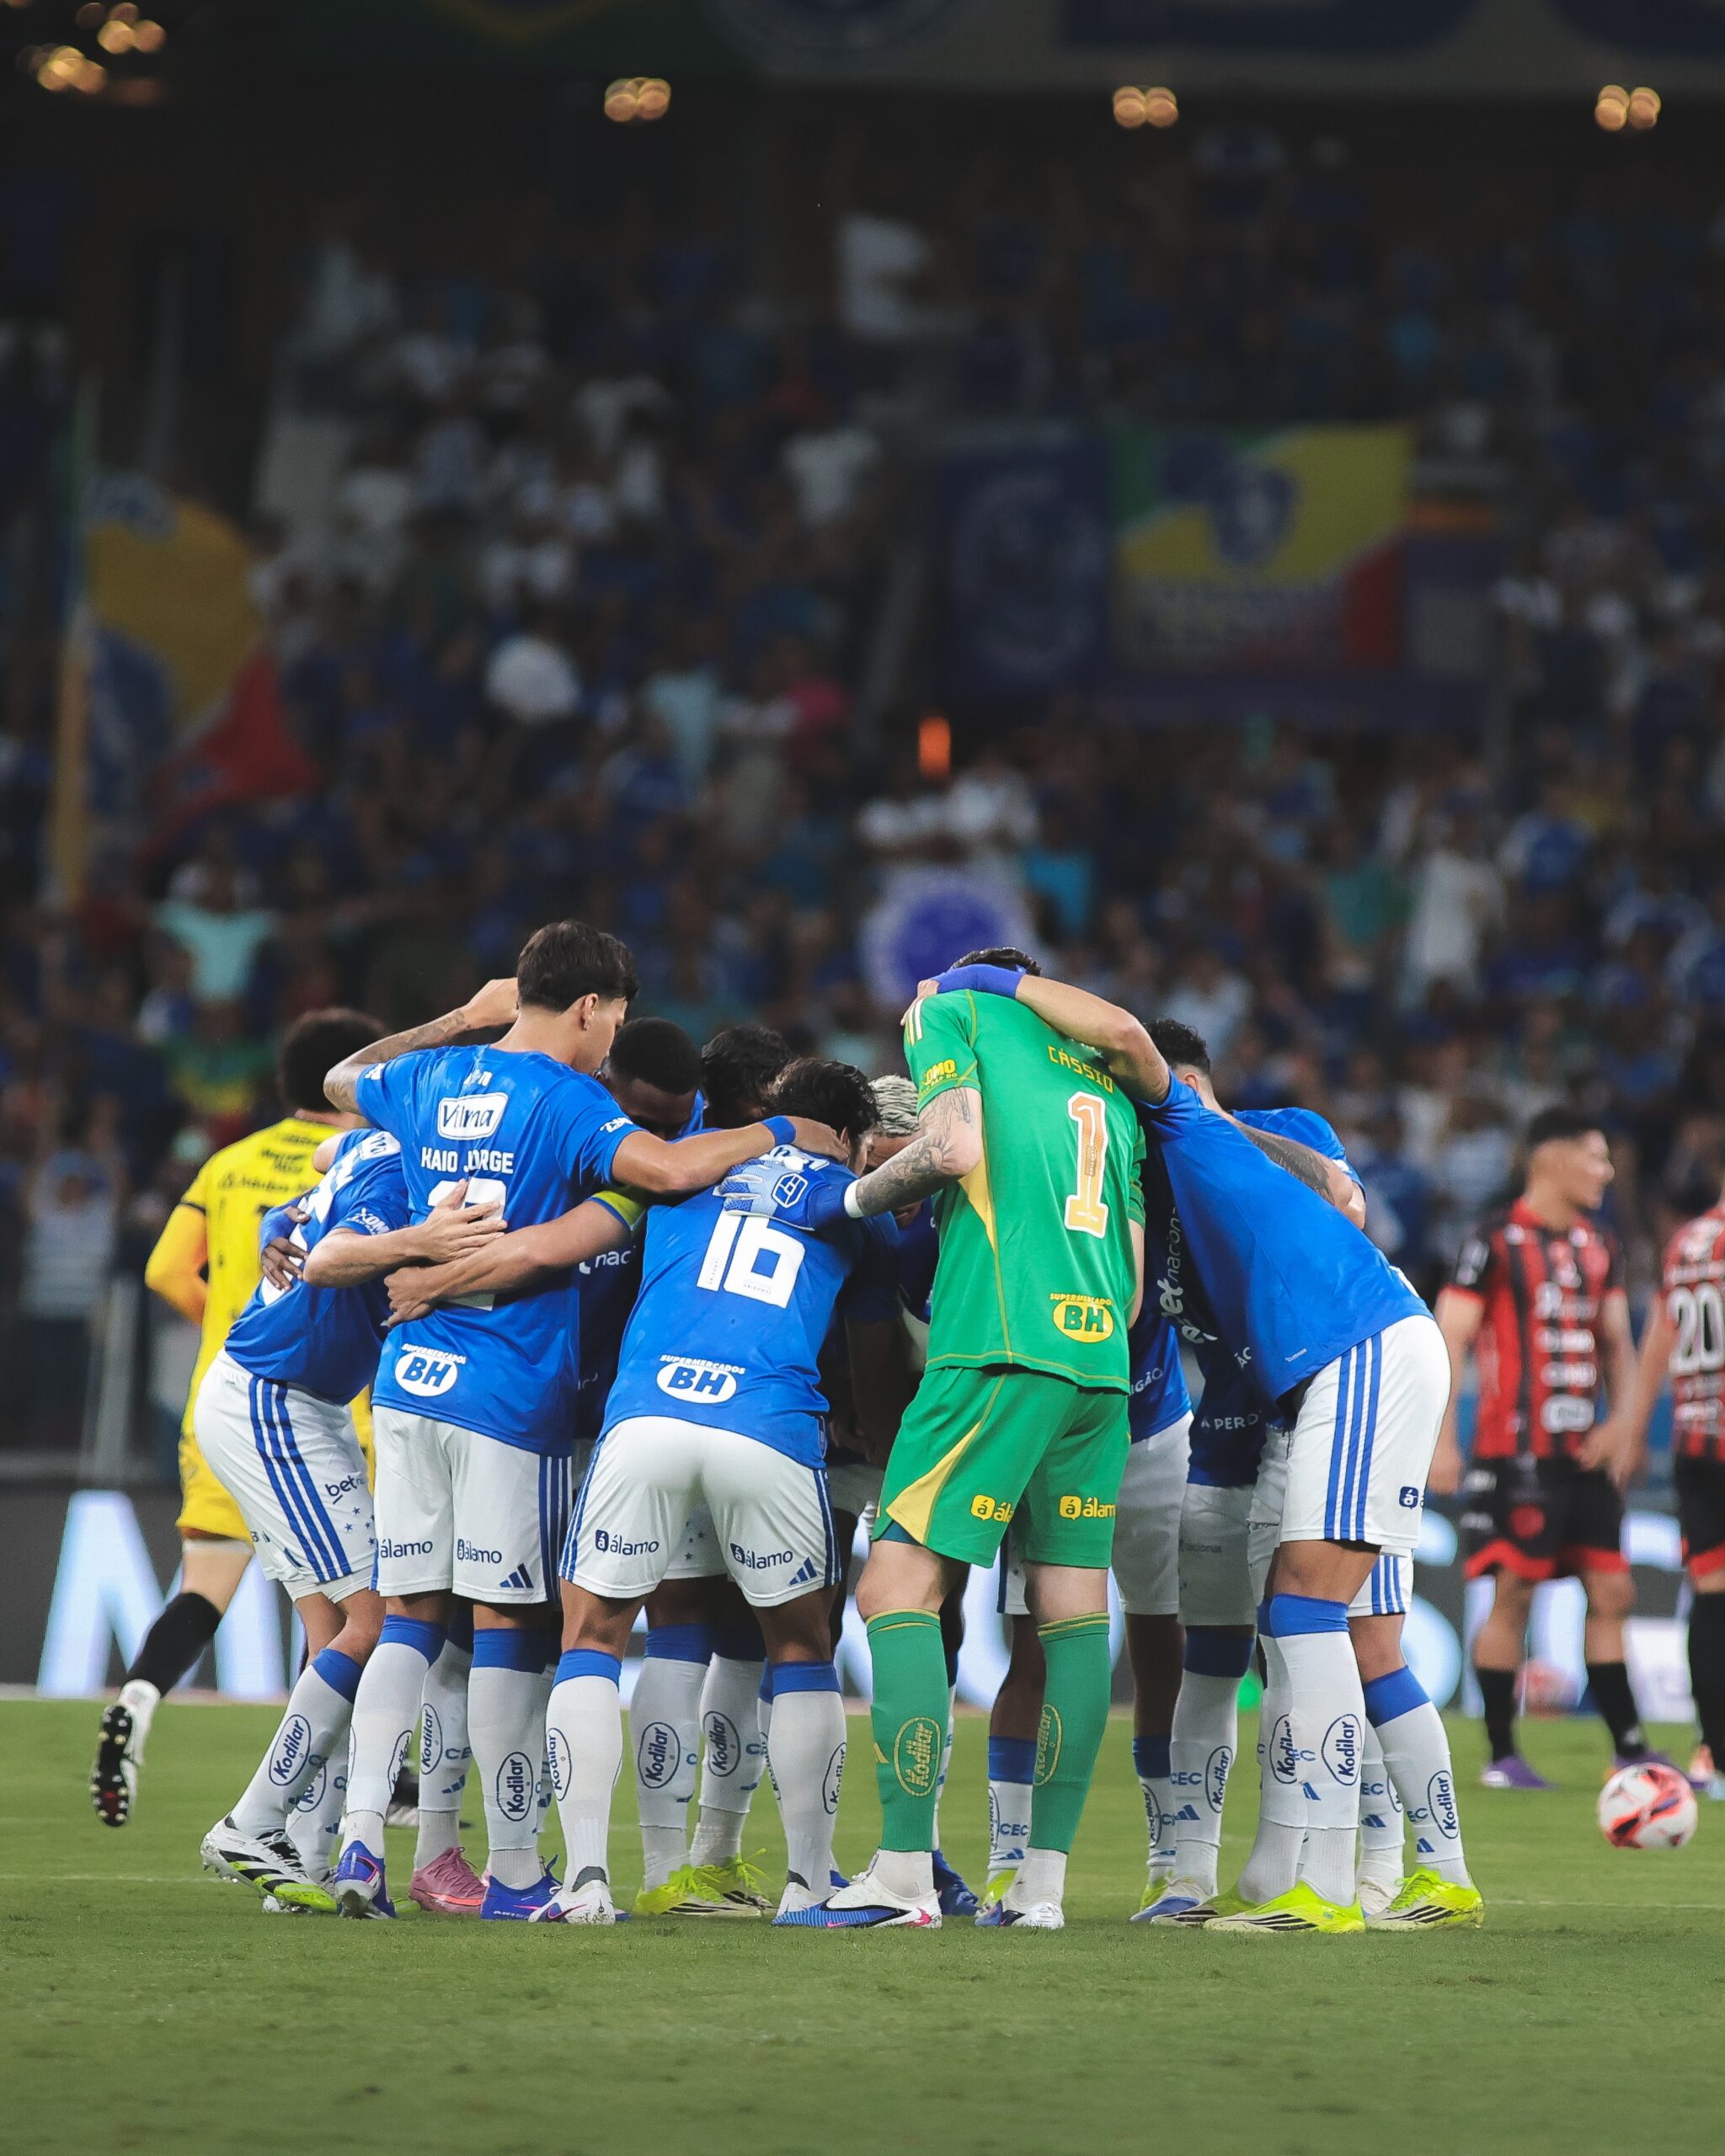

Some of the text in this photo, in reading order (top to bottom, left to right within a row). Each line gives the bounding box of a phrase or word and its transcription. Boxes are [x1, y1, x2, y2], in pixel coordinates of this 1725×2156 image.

[1048, 1044, 1114, 1094] CÁSSIO
[443, 1103, 494, 1129] Vilma
[421, 1146, 515, 1175] KAIO JORGE
[1065, 1091, 1109, 1239] 1
[697, 1206, 806, 1310] 16
[1167, 1206, 1183, 1283] nacion
[1064, 1305, 1104, 1333] BH
[1667, 1282, 1725, 1376] 20
[403, 1356, 452, 1388] BH
[660, 1354, 746, 1375] SUPERMERCADOS
[667, 1365, 729, 1396] BH
[381, 1538, 434, 1558] álamo
[464, 1541, 503, 1564] álamo
[610, 1534, 660, 1556] álamo
[745, 1550, 794, 1570] álamo
[273, 1719, 305, 1780] Kodilar
[421, 1709, 434, 1768] Kodilar
[645, 1726, 670, 1782] Kodilar
[708, 1716, 728, 1771] Kodilar
[905, 1722, 933, 1788] Kodilar
[1335, 1721, 1355, 1777] Kodilar
[506, 1758, 526, 1813] Kodilar
[1437, 1776, 1457, 1830] Kodilar
[1000, 1822, 1029, 1836] CEC
